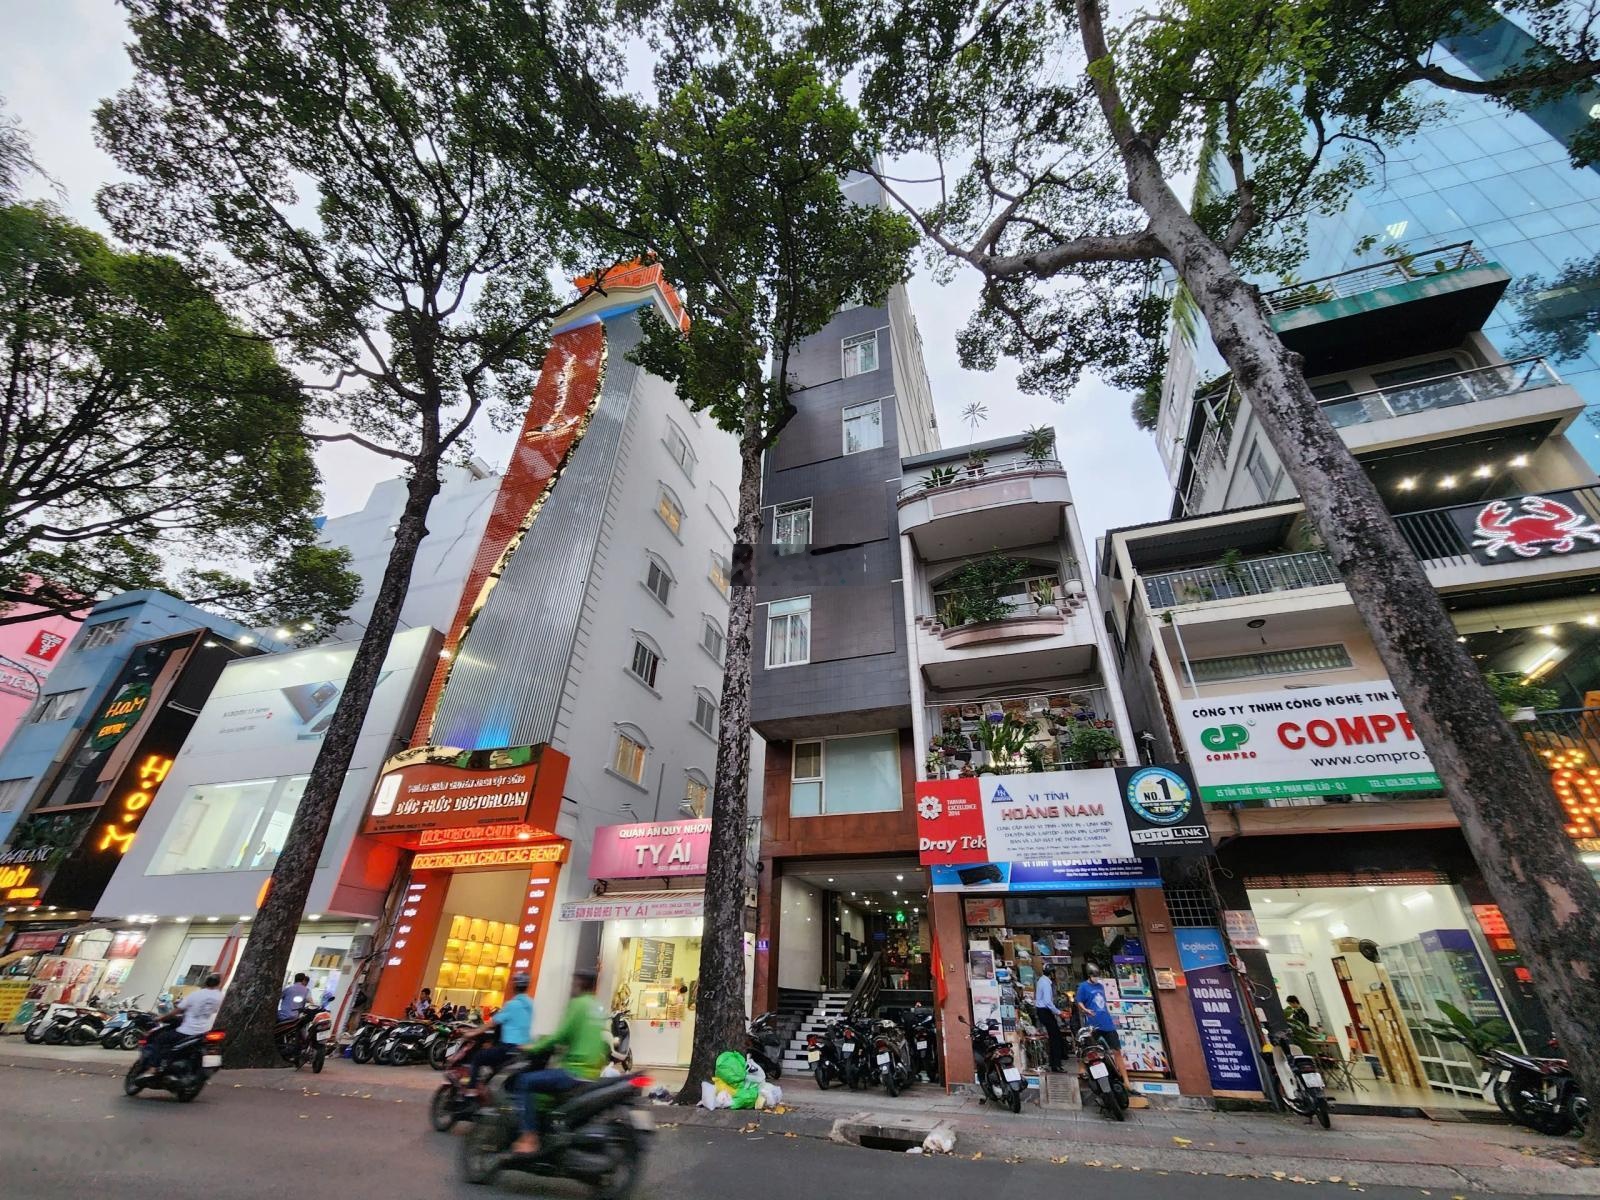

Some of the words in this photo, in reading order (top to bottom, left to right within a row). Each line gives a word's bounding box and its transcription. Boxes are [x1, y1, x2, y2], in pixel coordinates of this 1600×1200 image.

[1229, 705, 1244, 716] TY
[1249, 701, 1284, 714] TNHH
[1365, 692, 1389, 703] TIN
[1206, 751, 1257, 762] COMPRO
[1001, 803, 1059, 821] HOÀNG
[1064, 803, 1105, 817] NAM
[661, 825, 681, 836] QUY
[1173, 828, 1203, 837] LINK
[919, 836, 957, 854] Dray
[960, 835, 987, 850] Tek
[635, 843, 665, 866] TY
[614, 906, 633, 918] TY
[1181, 941, 1219, 954] logitech
[1192, 984, 1233, 1000] HOÀNG
[1202, 1001, 1231, 1014] NAM
